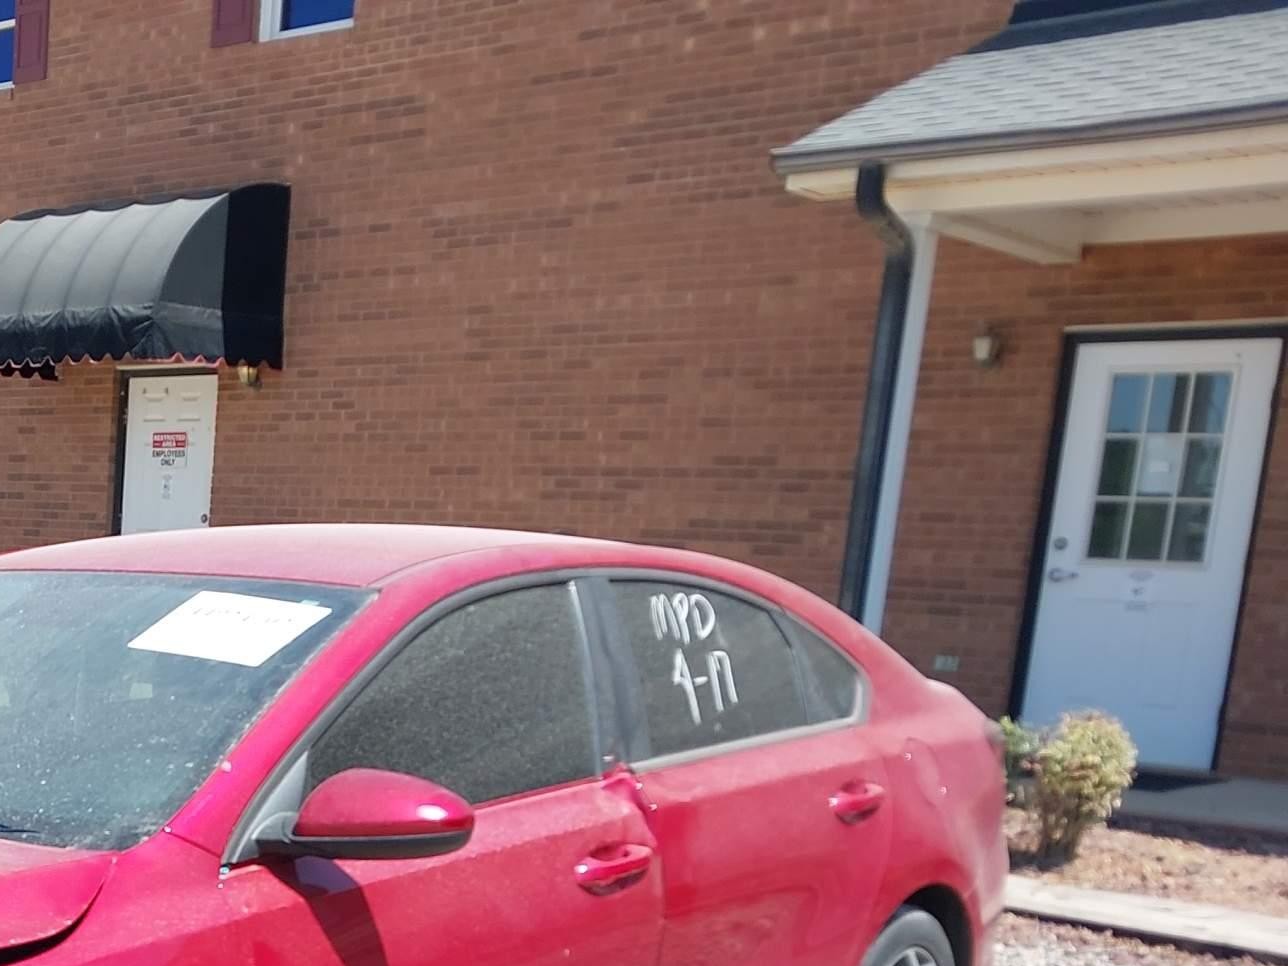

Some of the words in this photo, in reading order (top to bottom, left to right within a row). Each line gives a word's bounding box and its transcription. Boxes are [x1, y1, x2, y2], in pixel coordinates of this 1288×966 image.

[152, 449, 186, 458] EMPLOYEES
[160, 458, 176, 466] ONLY
[648, 592, 717, 645] MPD
